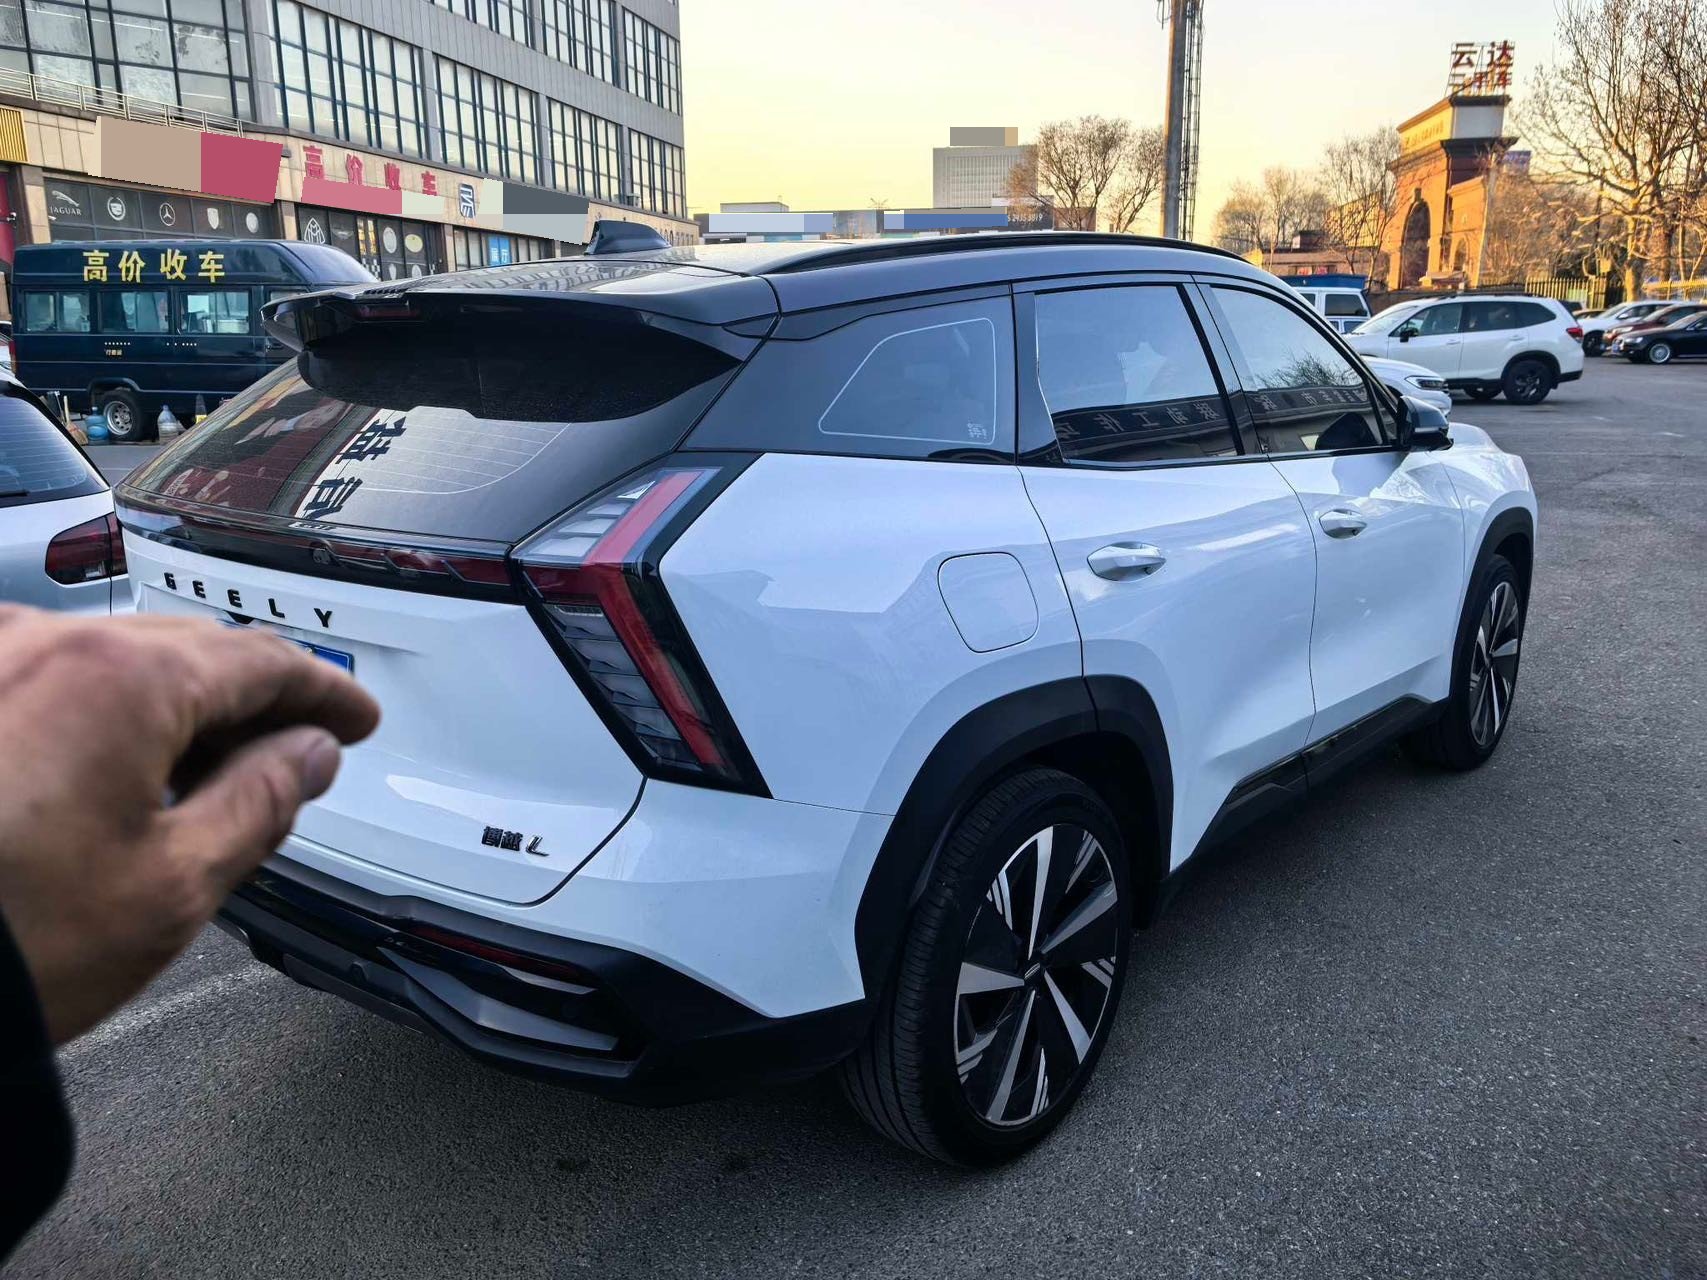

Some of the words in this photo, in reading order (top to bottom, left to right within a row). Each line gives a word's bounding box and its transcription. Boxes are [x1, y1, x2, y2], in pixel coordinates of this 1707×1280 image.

[1451, 40, 1514, 68] 云达
[50, 206, 82, 216] JAGUAR
[82, 249, 226, 283] 高价收车
[163, 572, 333, 628] GEELY
